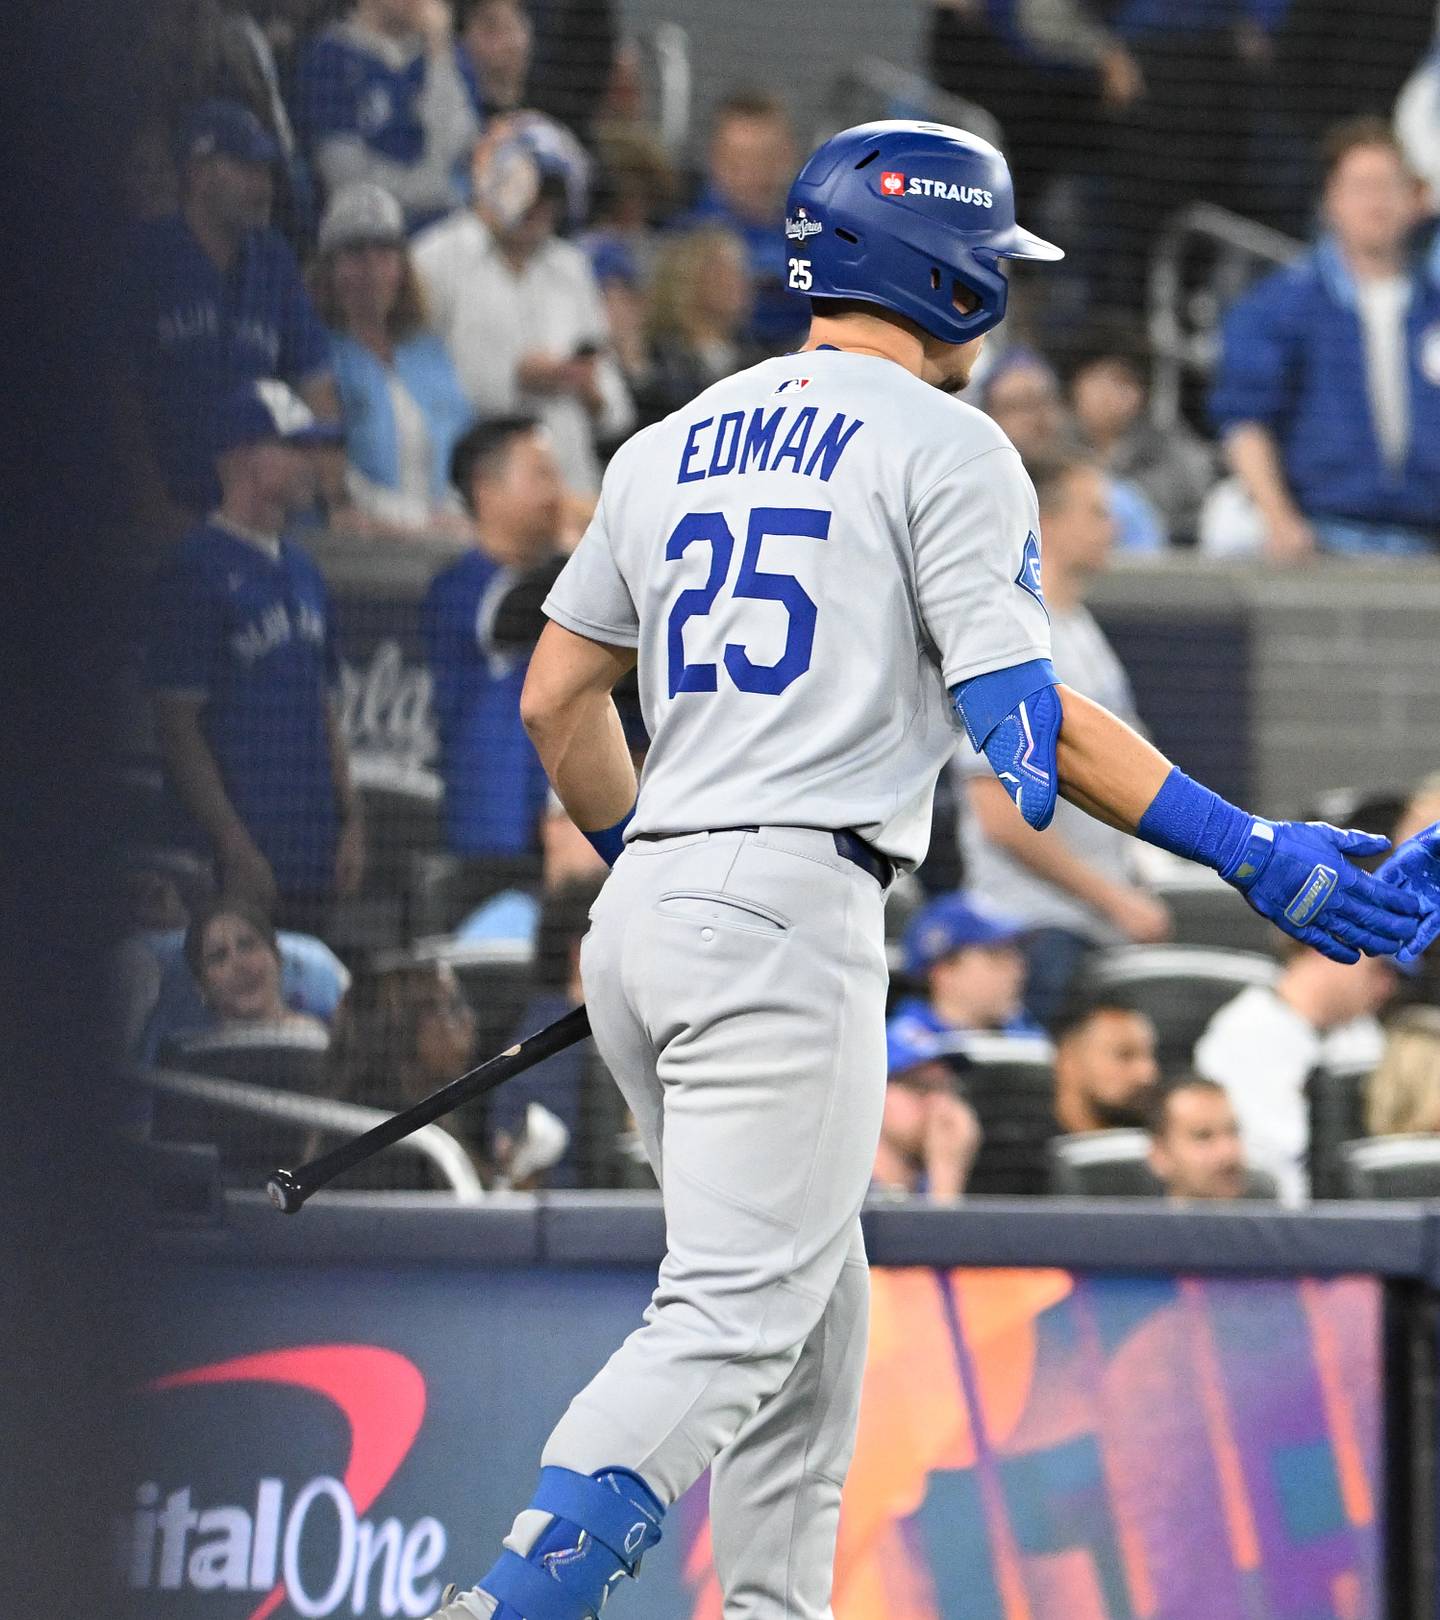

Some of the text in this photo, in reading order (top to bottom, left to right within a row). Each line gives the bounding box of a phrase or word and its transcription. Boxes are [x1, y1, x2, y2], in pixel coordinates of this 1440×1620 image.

[907, 177, 994, 209] STRAUSS
[788, 257, 814, 291] 25
[676, 406, 865, 485] EDMAN
[665, 506, 832, 700] 25
